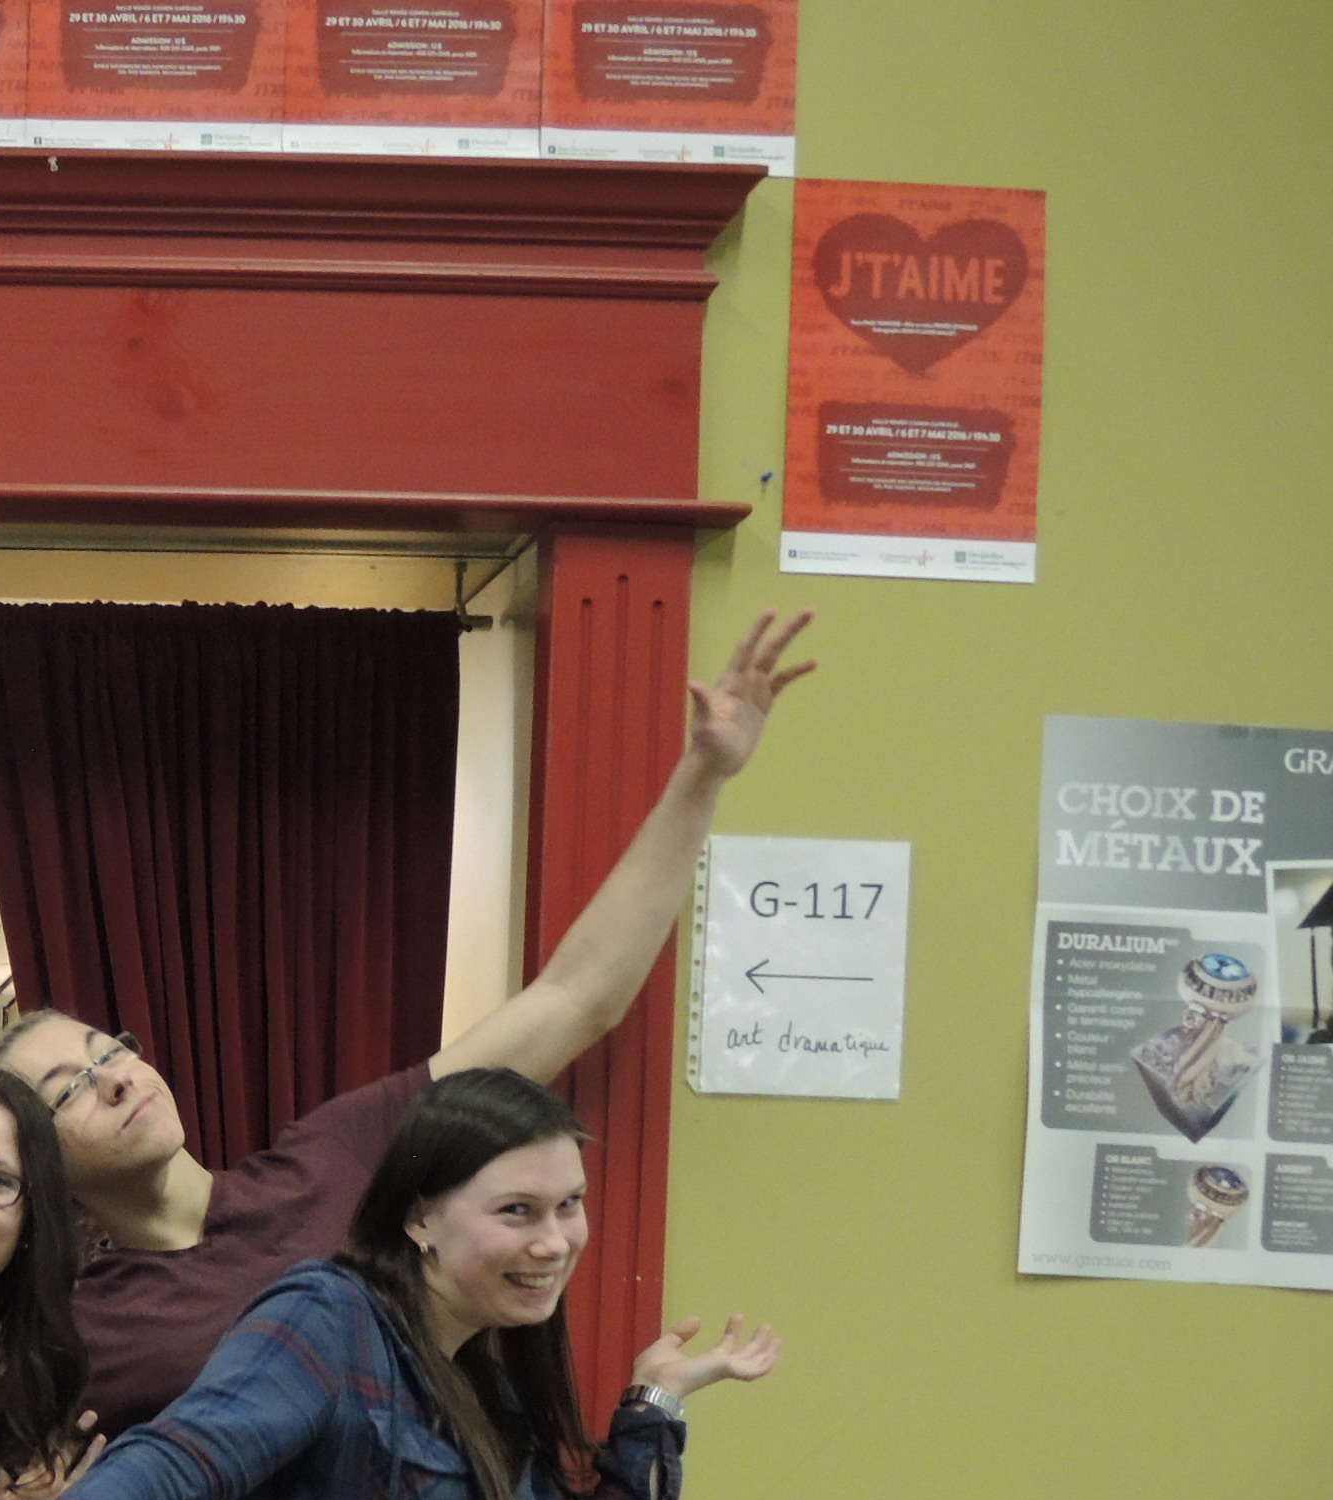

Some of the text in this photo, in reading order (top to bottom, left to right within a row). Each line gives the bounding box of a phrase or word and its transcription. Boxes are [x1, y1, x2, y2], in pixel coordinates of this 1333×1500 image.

[828, 251, 1007, 304] J'T'AIME
[1057, 781, 1266, 824] CHOIX DE
[1055, 818, 1263, 876] MÉTAUX
[750, 880, 884, 920] G-117
[727, 1021, 891, 1058] art dramatique
